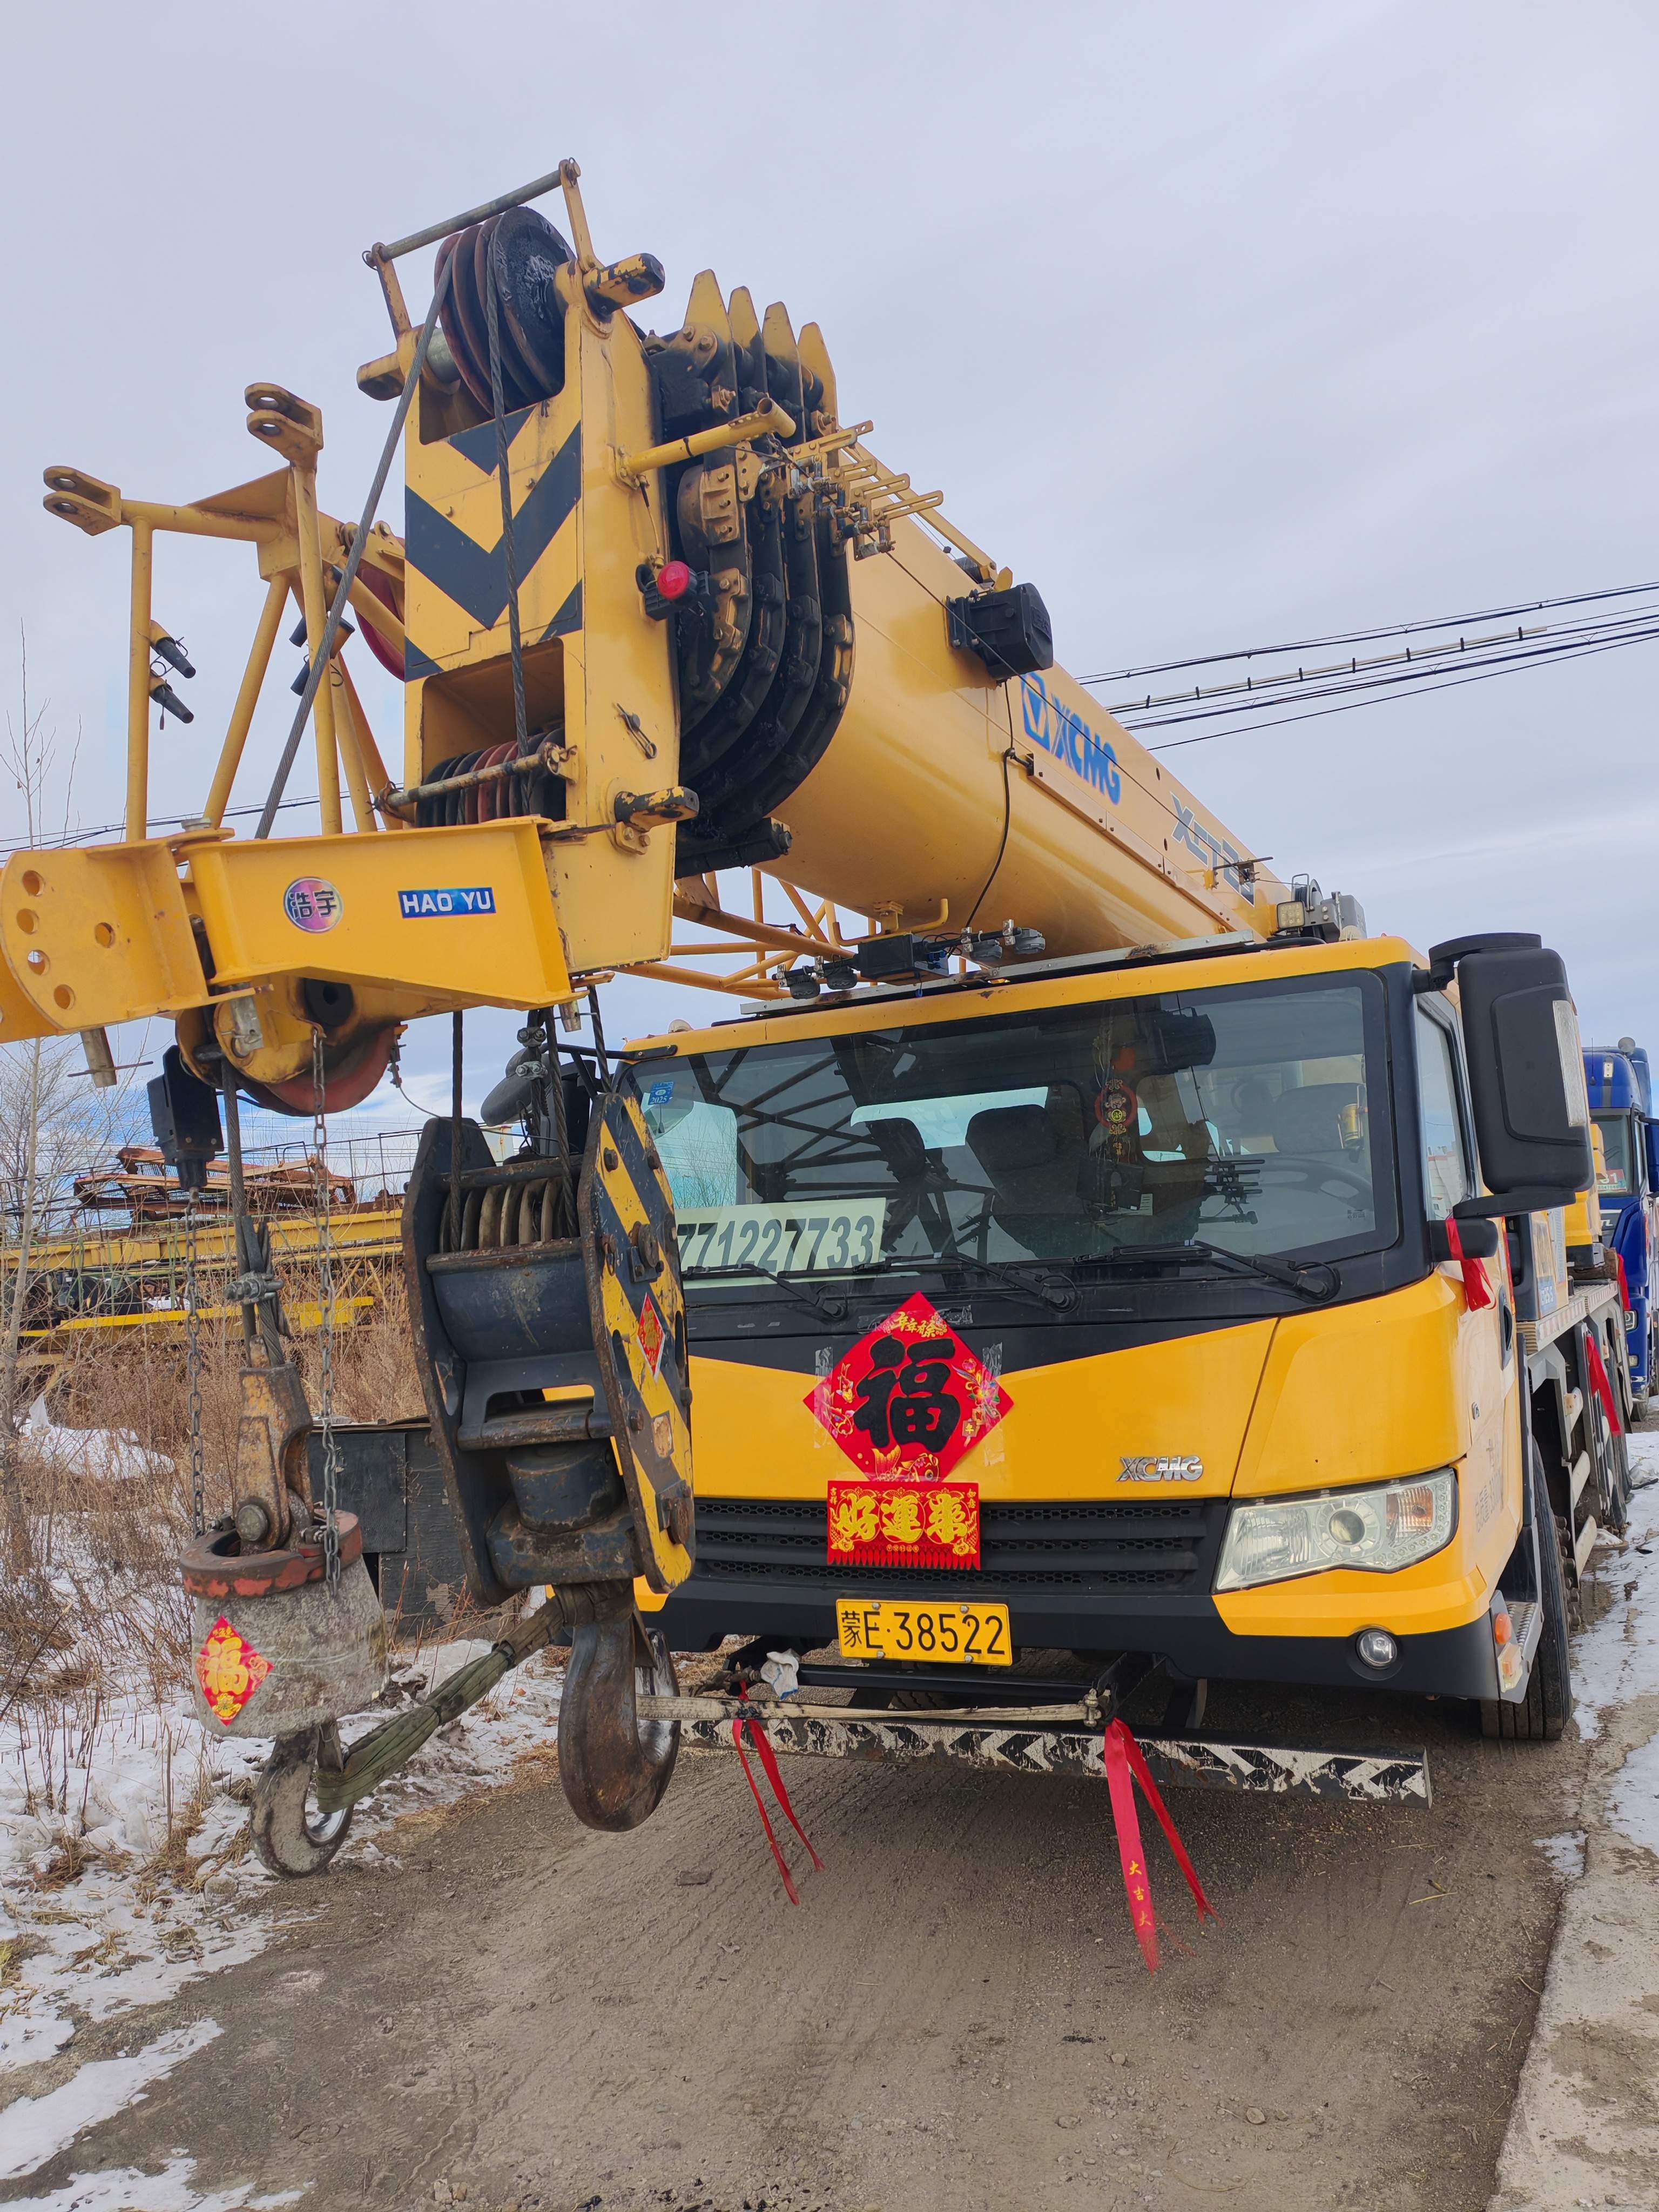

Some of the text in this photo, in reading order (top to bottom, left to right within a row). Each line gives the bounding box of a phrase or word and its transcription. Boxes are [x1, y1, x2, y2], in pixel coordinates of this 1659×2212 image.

[1050, 693, 1121, 805] XCMG
[288, 890, 337, 920] 浩宇
[402, 891, 492, 914] HAO YU
[853, 1335, 961, 1453] 福
[1116, 1456, 1203, 1481] XCMG
[205, 1636, 249, 1695] 福
[1129, 1860, 1151, 1926] 大吉大
